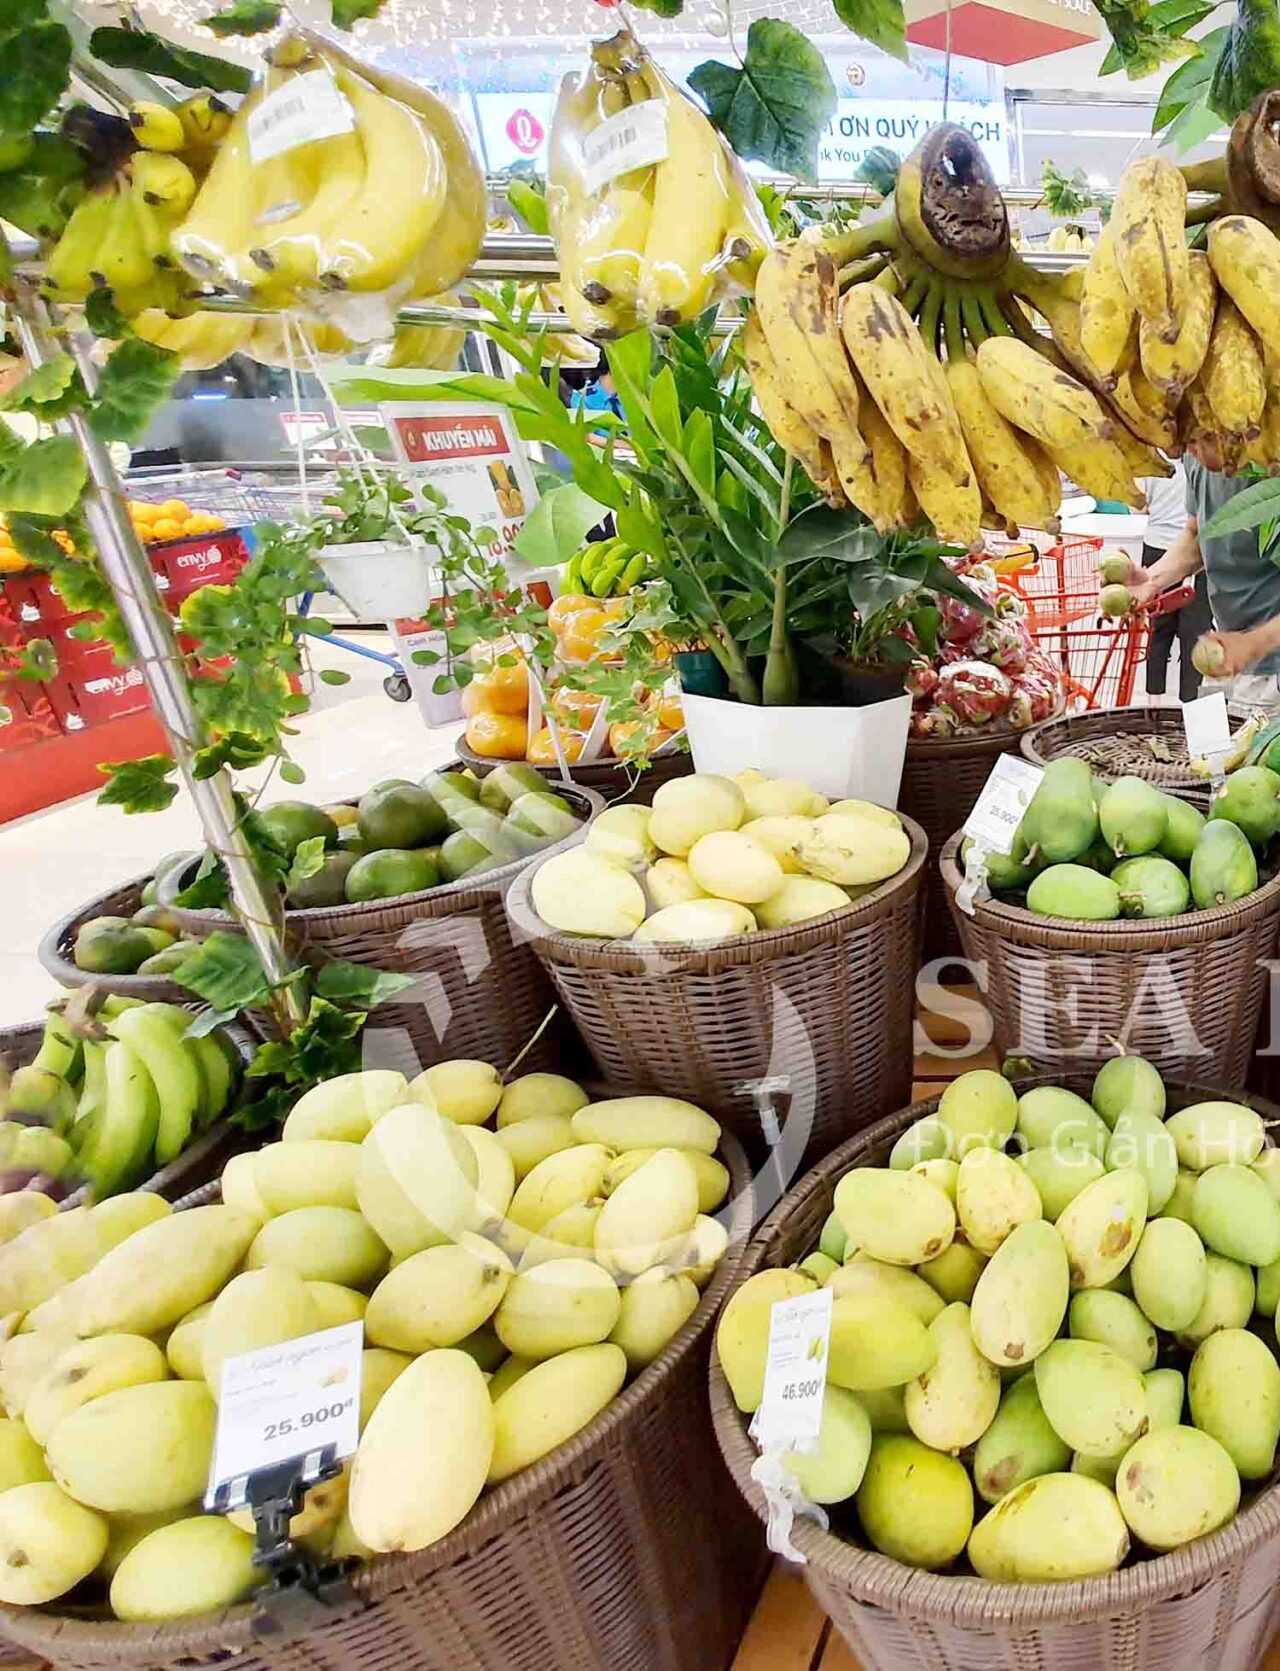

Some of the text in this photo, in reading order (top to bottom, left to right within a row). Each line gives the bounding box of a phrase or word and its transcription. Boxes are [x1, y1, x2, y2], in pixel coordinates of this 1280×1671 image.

[876, 115, 919, 139] QUÝ
[835, 149, 860, 163] You
[177, 552, 205, 572] envy
